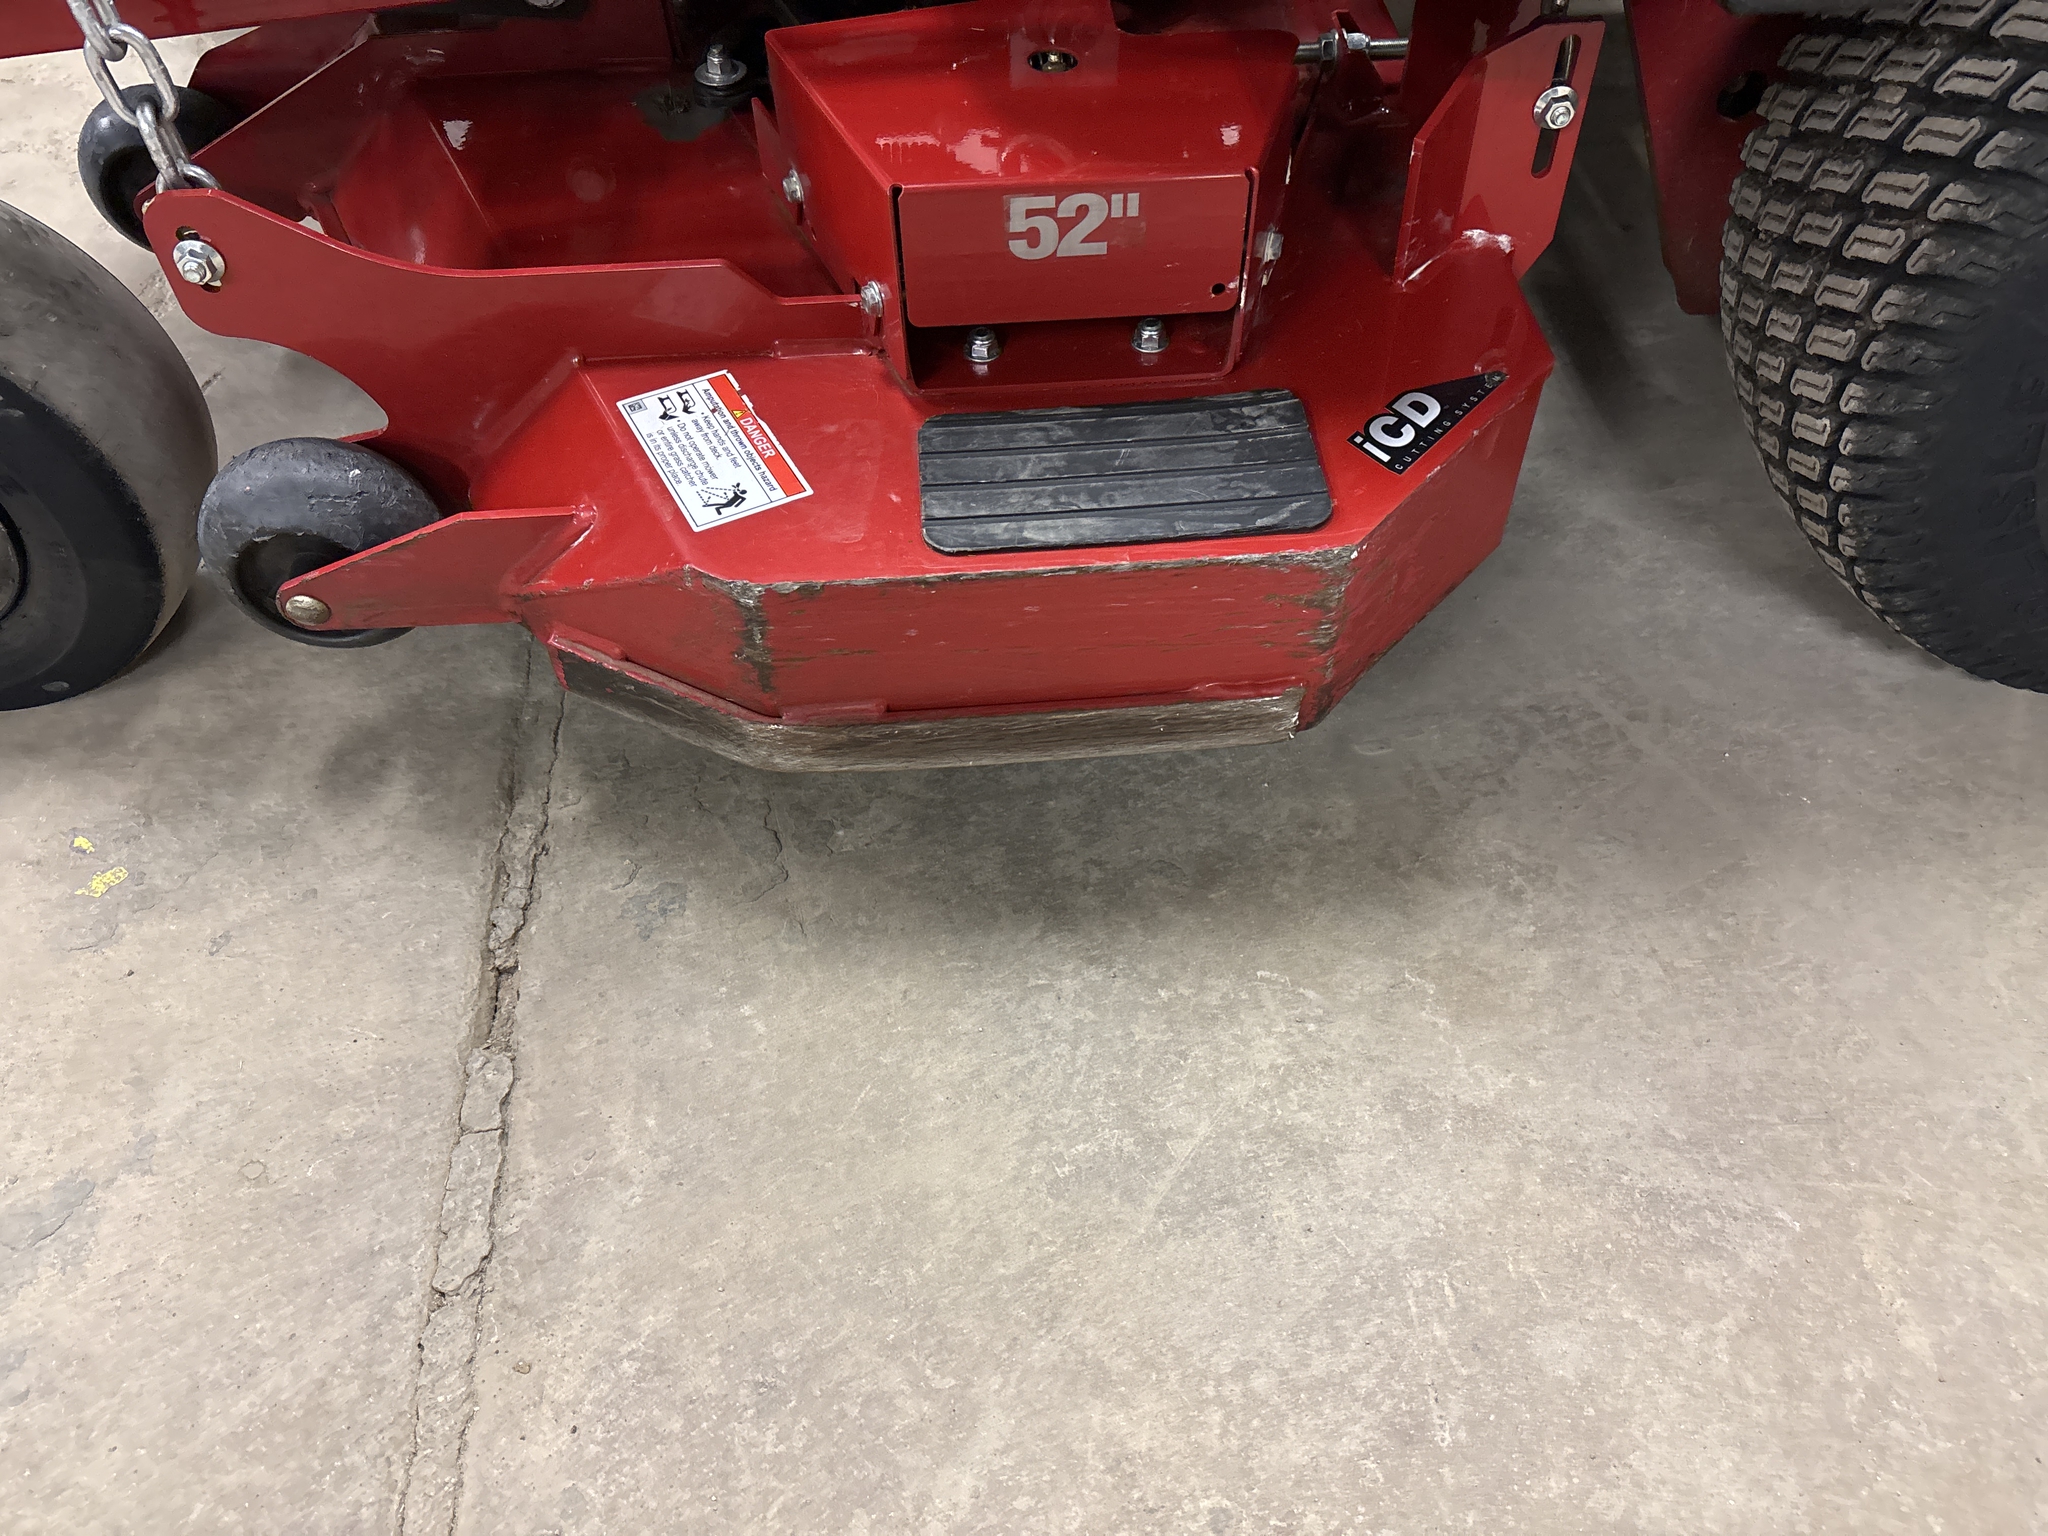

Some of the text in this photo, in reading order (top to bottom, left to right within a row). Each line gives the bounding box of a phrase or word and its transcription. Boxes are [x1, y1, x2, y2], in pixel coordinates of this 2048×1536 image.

[1008, 192, 1140, 260] 52"
[677, 422, 719, 480] Do not operate mower
[691, 418, 705, 433] away
[700, 432, 713, 446] from
[702, 388, 778, 492] Amputation and thrown objects hazard
[703, 415, 742, 469] Keep hands and feet
[740, 417, 776, 459] DANGER
[1353, 392, 1442, 463] iCD
[1395, 375, 1501, 471] CUTTING SYSTEM
[656, 451, 673, 469] proper
[660, 436, 674, 451] entire
[669, 451, 684, 467] grass
[679, 466, 698, 487] catcher
[667, 426, 708, 486] unless discharge chute
